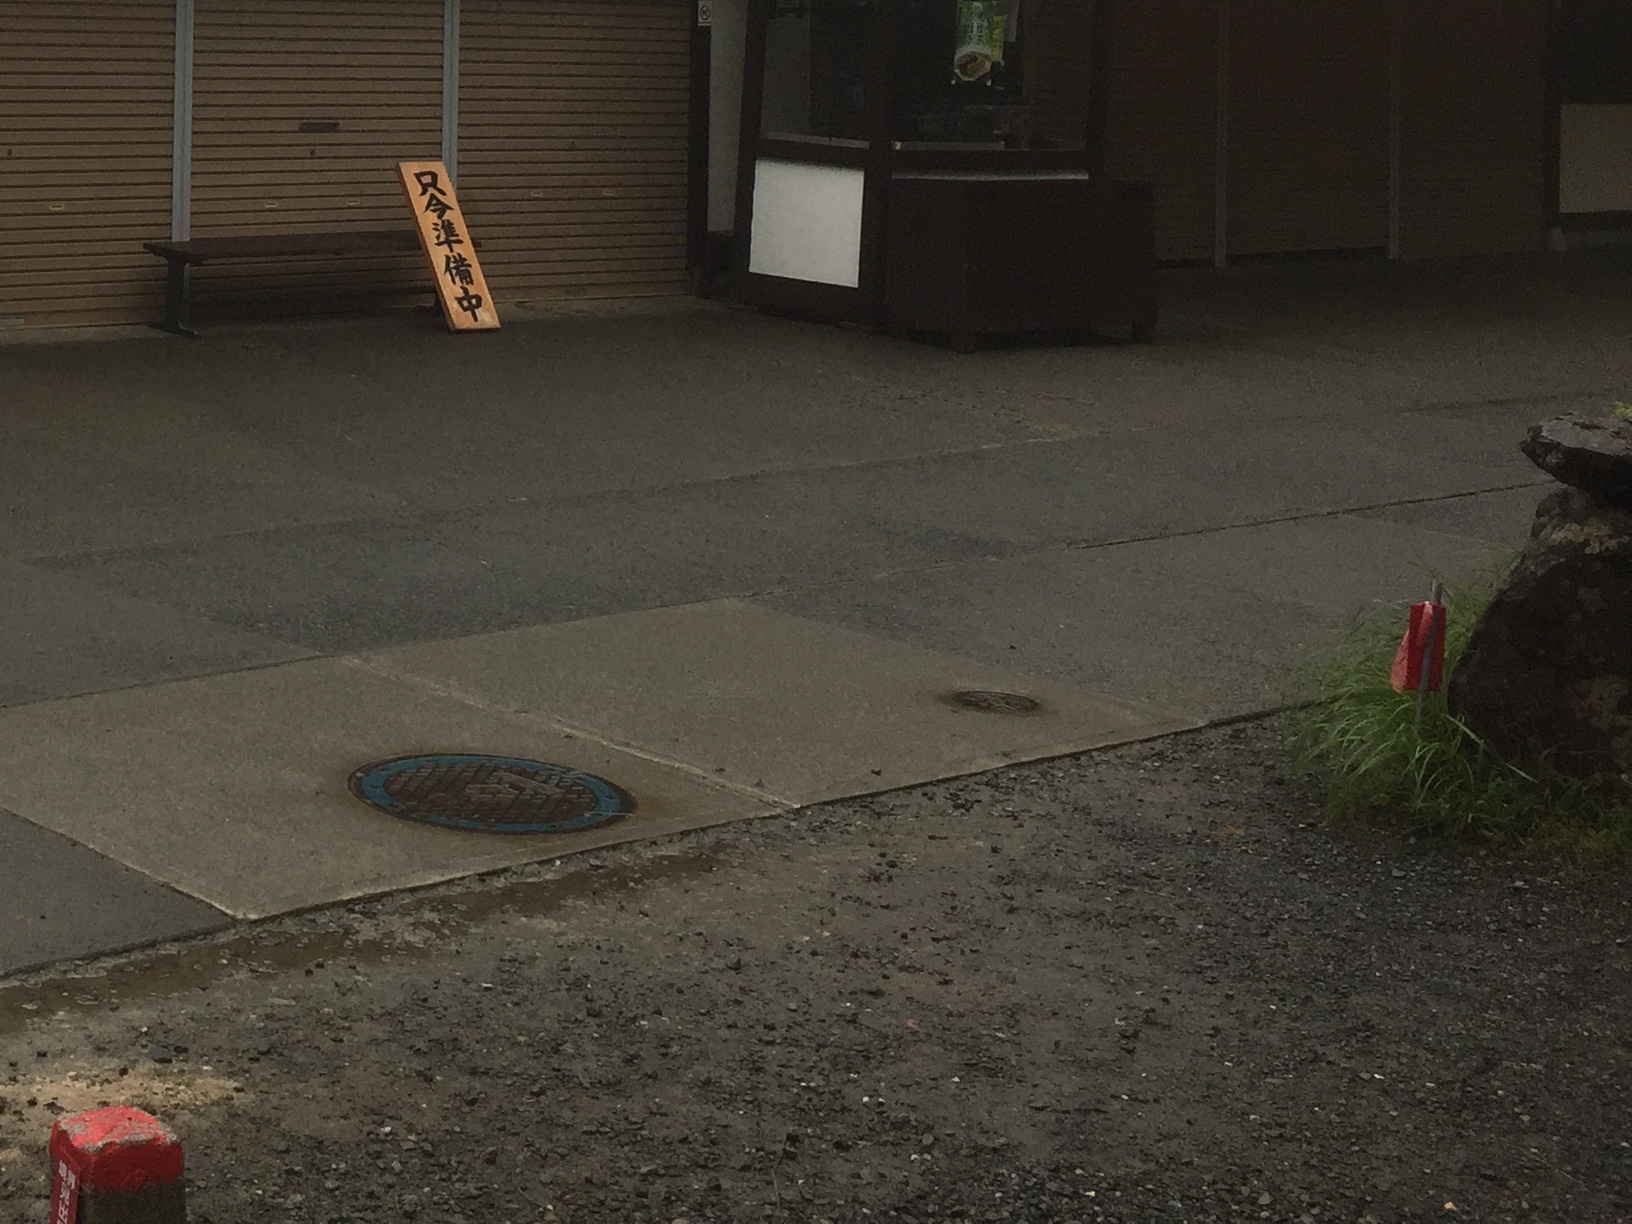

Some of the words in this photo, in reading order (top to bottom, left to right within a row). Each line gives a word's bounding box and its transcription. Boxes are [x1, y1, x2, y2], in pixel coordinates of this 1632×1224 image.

[413, 170, 482, 323] 只今準備中
